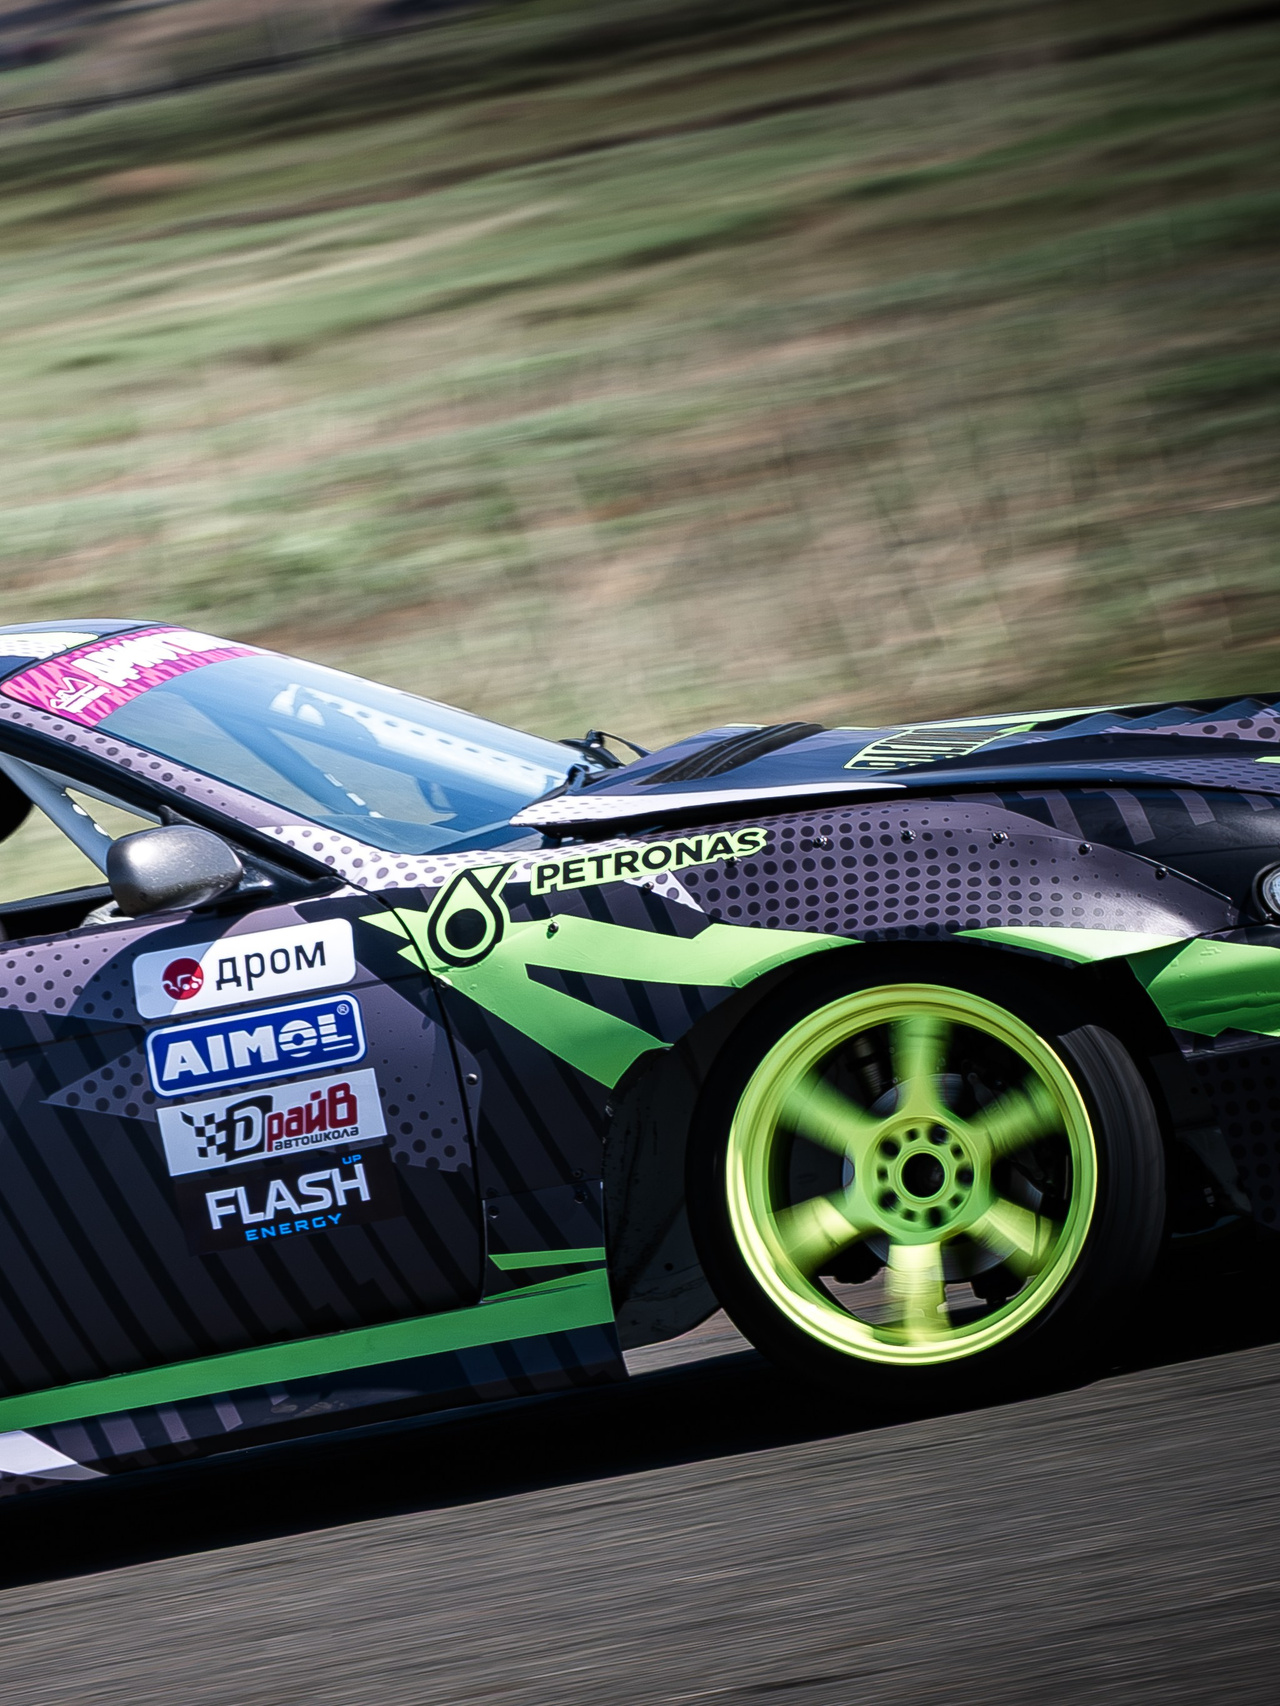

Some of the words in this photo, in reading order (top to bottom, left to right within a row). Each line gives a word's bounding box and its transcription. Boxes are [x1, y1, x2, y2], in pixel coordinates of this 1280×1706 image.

[536, 830, 762, 889] PETRONAS
[216, 941, 327, 991] дром
[162, 1013, 354, 1081] AIMOL
[274, 1126, 359, 1152] автошкола
[341, 1154, 362, 1164] UP
[205, 1163, 371, 1230] FLASH
[245, 1212, 342, 1242] ENERGY
